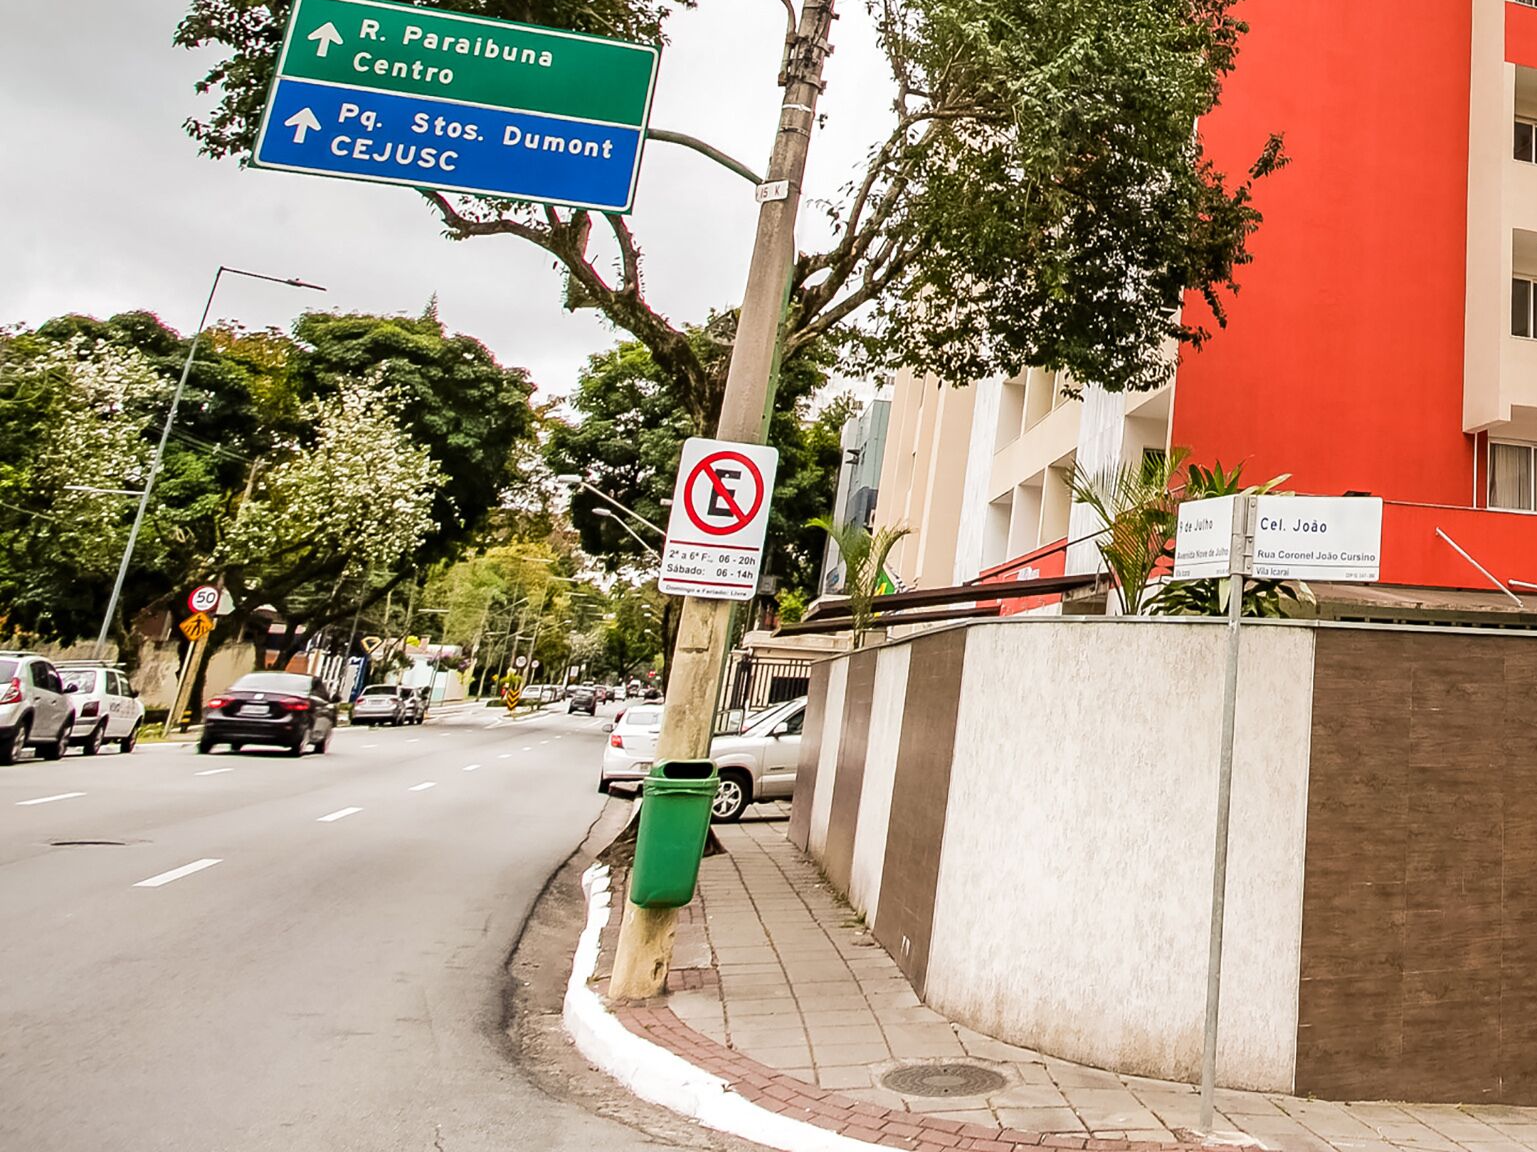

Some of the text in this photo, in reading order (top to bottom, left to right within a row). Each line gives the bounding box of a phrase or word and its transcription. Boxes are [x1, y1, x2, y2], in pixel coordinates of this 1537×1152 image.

[359, 19, 553, 67] R. Paraibuna
[353, 52, 454, 85] Centro
[338, 103, 613, 159] Pq. Stos. Dumont
[331, 135, 458, 171] CEJUSC
[1185, 521, 1192, 533] de
[1194, 518, 1213, 531] Julho
[1260, 517, 1327, 533] Cel. João
[718, 554, 730, 564] 06
[738, 556, 756, 565] 20h
[1257, 549, 1376, 561] Rua Coronel João Cursino
[666, 563, 705, 576] Sábado:
[716, 568, 728, 577] 06
[737, 570, 753, 579] 14h
[1257, 567, 1268, 575] Vila
[196, 591, 216, 603] 50
